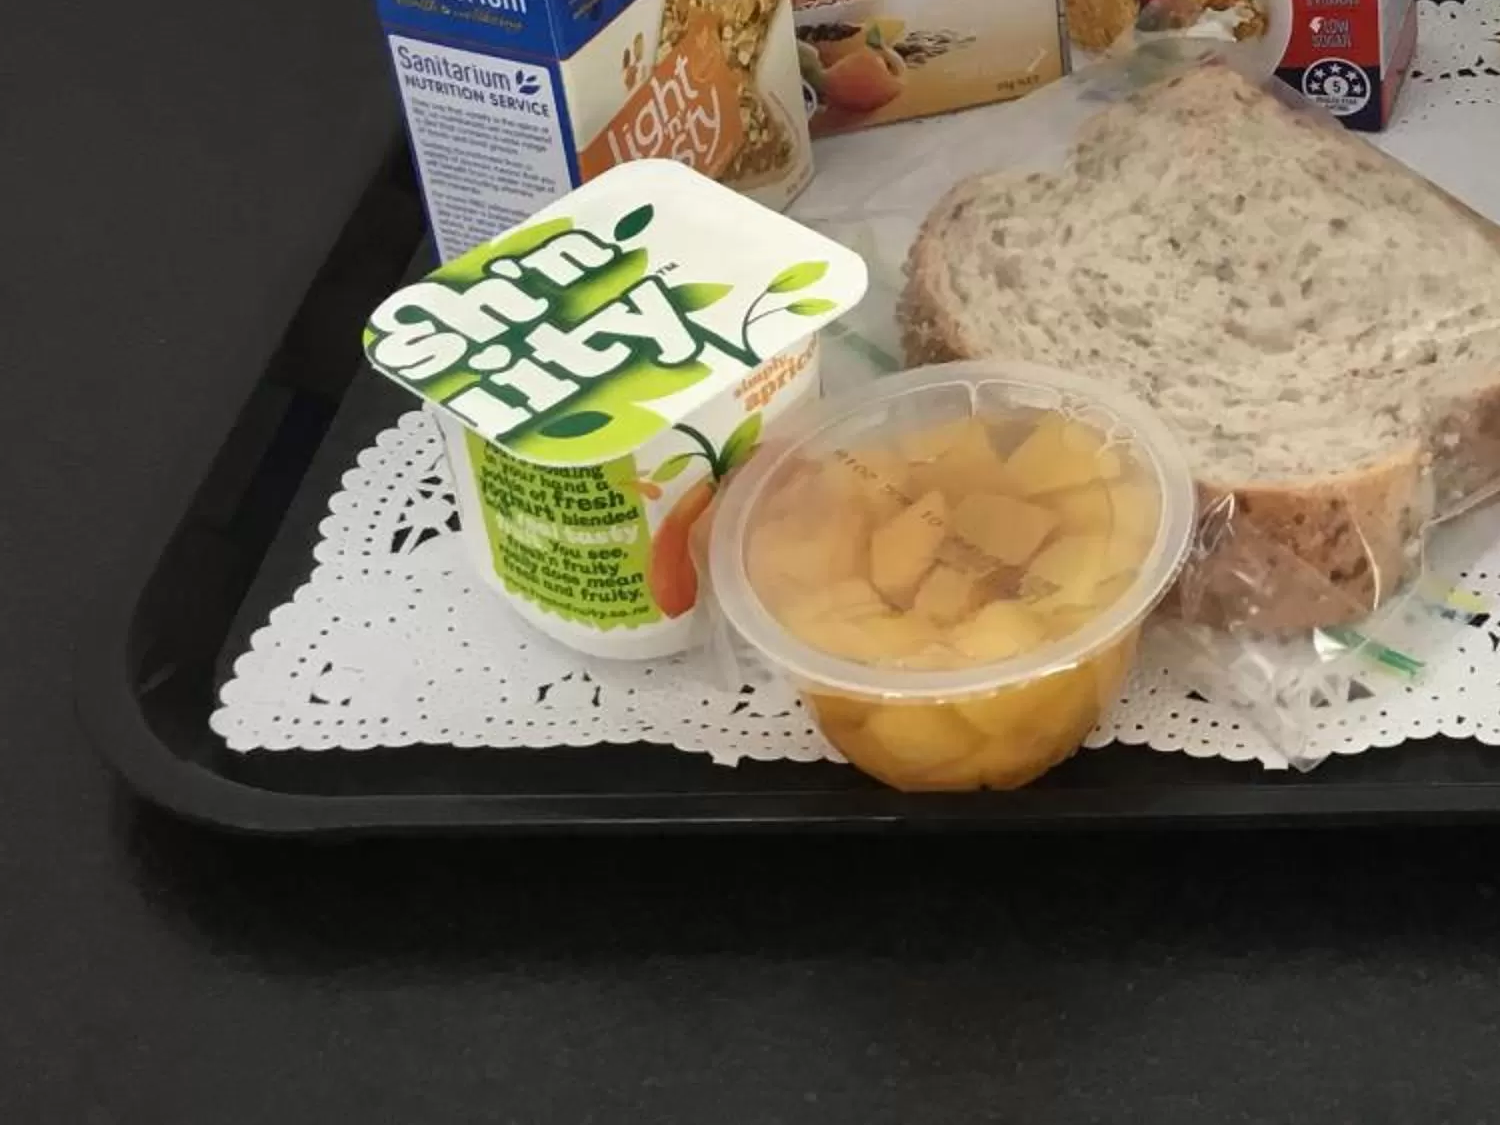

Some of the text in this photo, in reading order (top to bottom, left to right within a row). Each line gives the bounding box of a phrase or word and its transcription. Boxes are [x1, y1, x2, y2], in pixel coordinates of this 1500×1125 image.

[397, 46, 512, 91] Sanitarium
[404, 76, 550, 117] NUTRITION SERVICE
[553, 489, 625, 512] fresh
[562, 505, 640, 525] blended
[563, 558, 619, 578] fruity
[587, 572, 644, 588] mean
